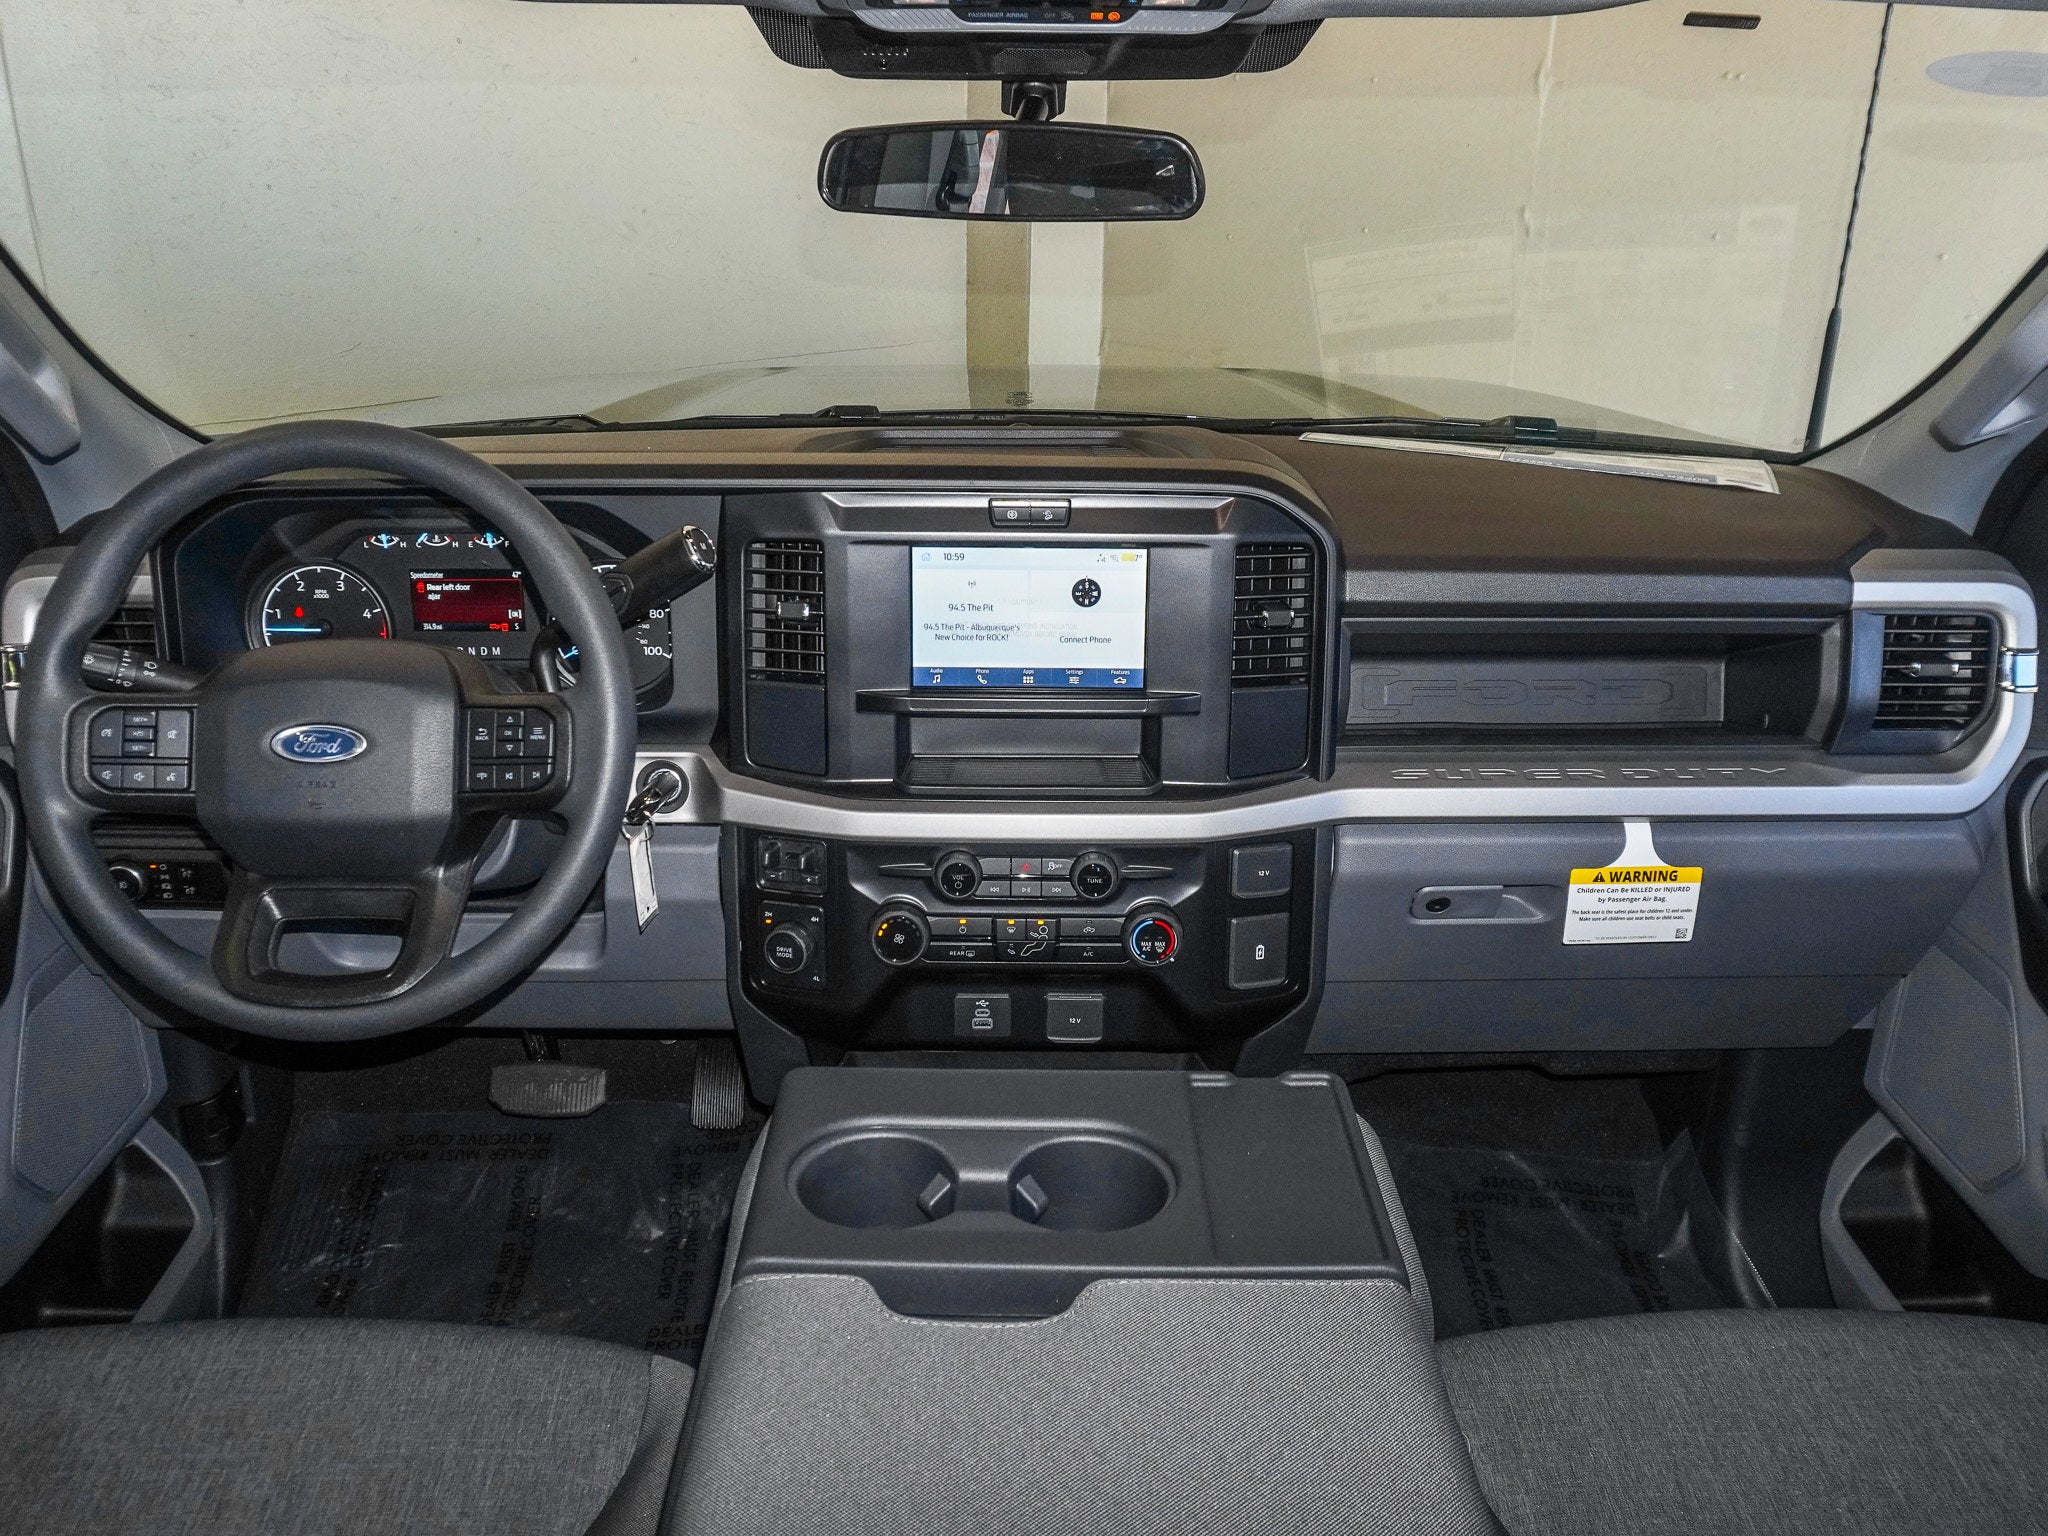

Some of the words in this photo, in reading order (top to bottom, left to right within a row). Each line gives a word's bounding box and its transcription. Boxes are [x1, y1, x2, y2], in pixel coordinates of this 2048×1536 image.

[943, 553, 965, 561] 10:59
[297, 581, 305, 591] 2
[336, 581, 345, 591] 3
[363, 608, 372, 618] 4
[948, 604, 966, 612] 94.5
[967, 604, 982, 612] The
[983, 604, 994, 612] Pit
[275, 609, 281, 619] 1
[649, 610, 664, 618] 80
[970, 623, 1020, 633] Albuquerque's
[935, 633, 950, 642] New
[951, 633, 974, 642] Choice
[975, 633, 986, 642] for
[986, 633, 1008, 642] ROCK!
[1059, 636, 1087, 644] Connect
[1089, 636, 1112, 644] Phone
[643, 646, 662, 655] 100
[1391, 767, 1606, 780] SUPER
[1620, 767, 1786, 780] DUTY
[1609, 870, 1678, 882] WARNING
[394, 1134, 454, 1146] COVER
[457, 1132, 552, 1146] PROTECTIVE
[438, 1149, 480, 1162] MUST
[490, 1148, 550, 1160] DEALER
[1470, 1288, 1494, 1331] COVE
[648, 1324, 708, 1339] DEALE
[644, 1338, 702, 1350] PROTE
